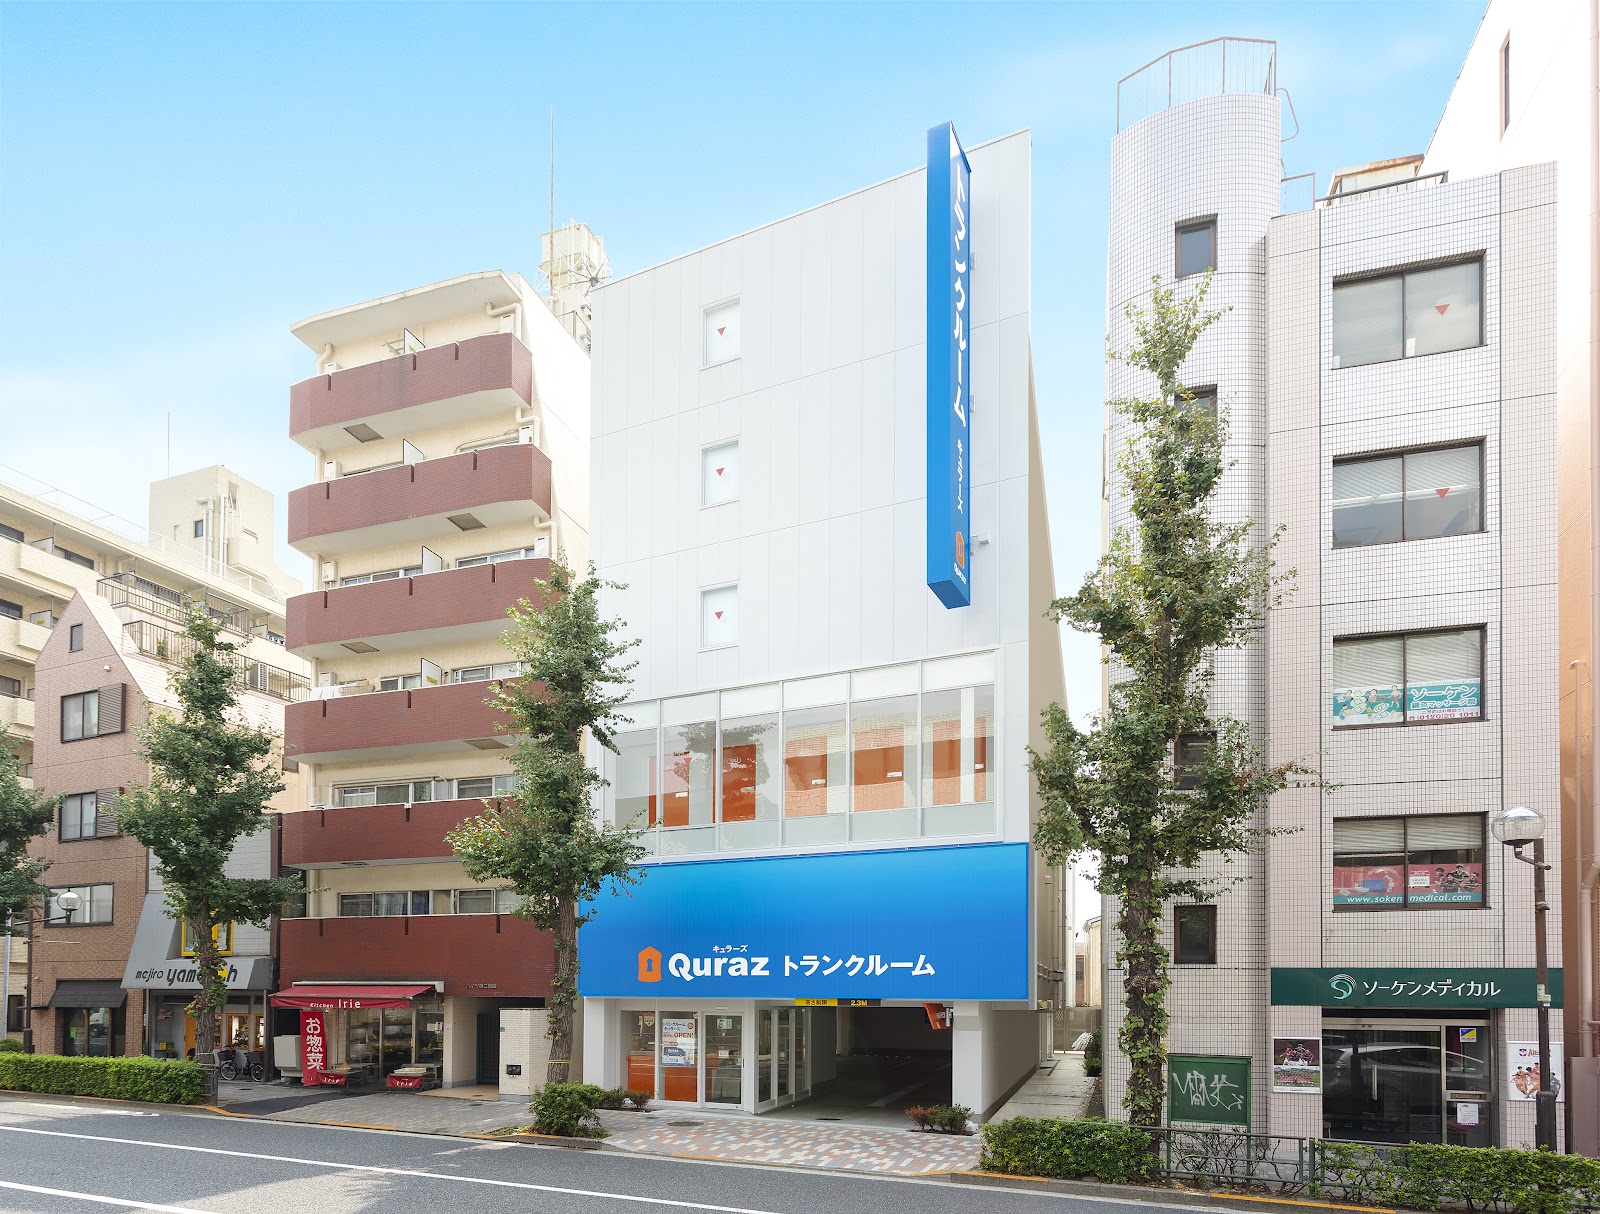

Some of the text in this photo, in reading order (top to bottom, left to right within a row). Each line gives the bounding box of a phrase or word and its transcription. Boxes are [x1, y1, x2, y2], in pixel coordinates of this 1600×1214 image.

[954, 162, 966, 428] トランクルーム
[1411, 685, 1477, 701] ソーケン
[1409, 893, 1472, 902] medical.com
[712, 944, 748, 953] キュラーズ
[668, 952, 769, 982] Quraz
[784, 954, 936, 977] トランクルーム
[135, 968, 164, 983] mejiro
[1362, 978, 1502, 997] ソーケンメディカル
[338, 998, 361, 1009] Irie
[305, 1017, 324, 1070] お惣菜
